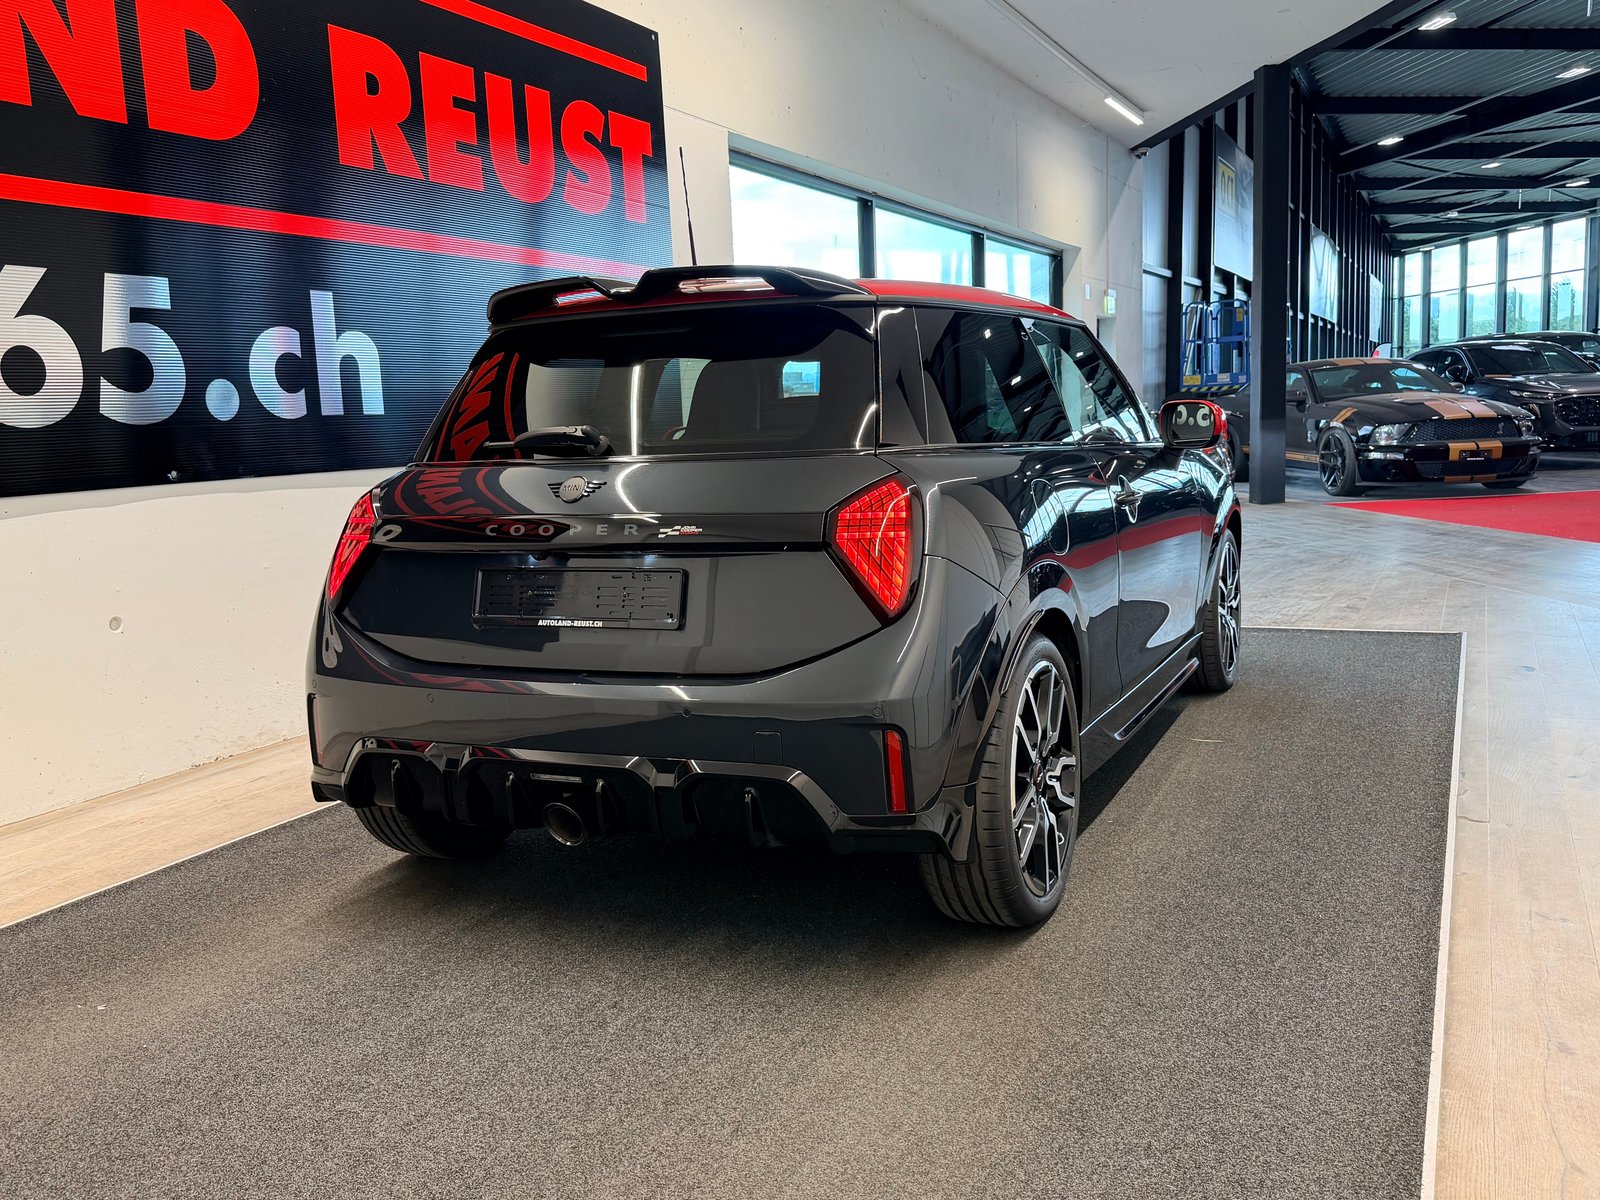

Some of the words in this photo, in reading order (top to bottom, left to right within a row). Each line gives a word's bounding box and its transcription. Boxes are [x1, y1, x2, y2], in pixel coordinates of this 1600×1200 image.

[327, 23, 653, 224] REUST
[562, 484, 583, 492] MINI
[485, 524, 640, 536] COOPER
[537, 619, 603, 628] AUTOLAND-REUST.CH
